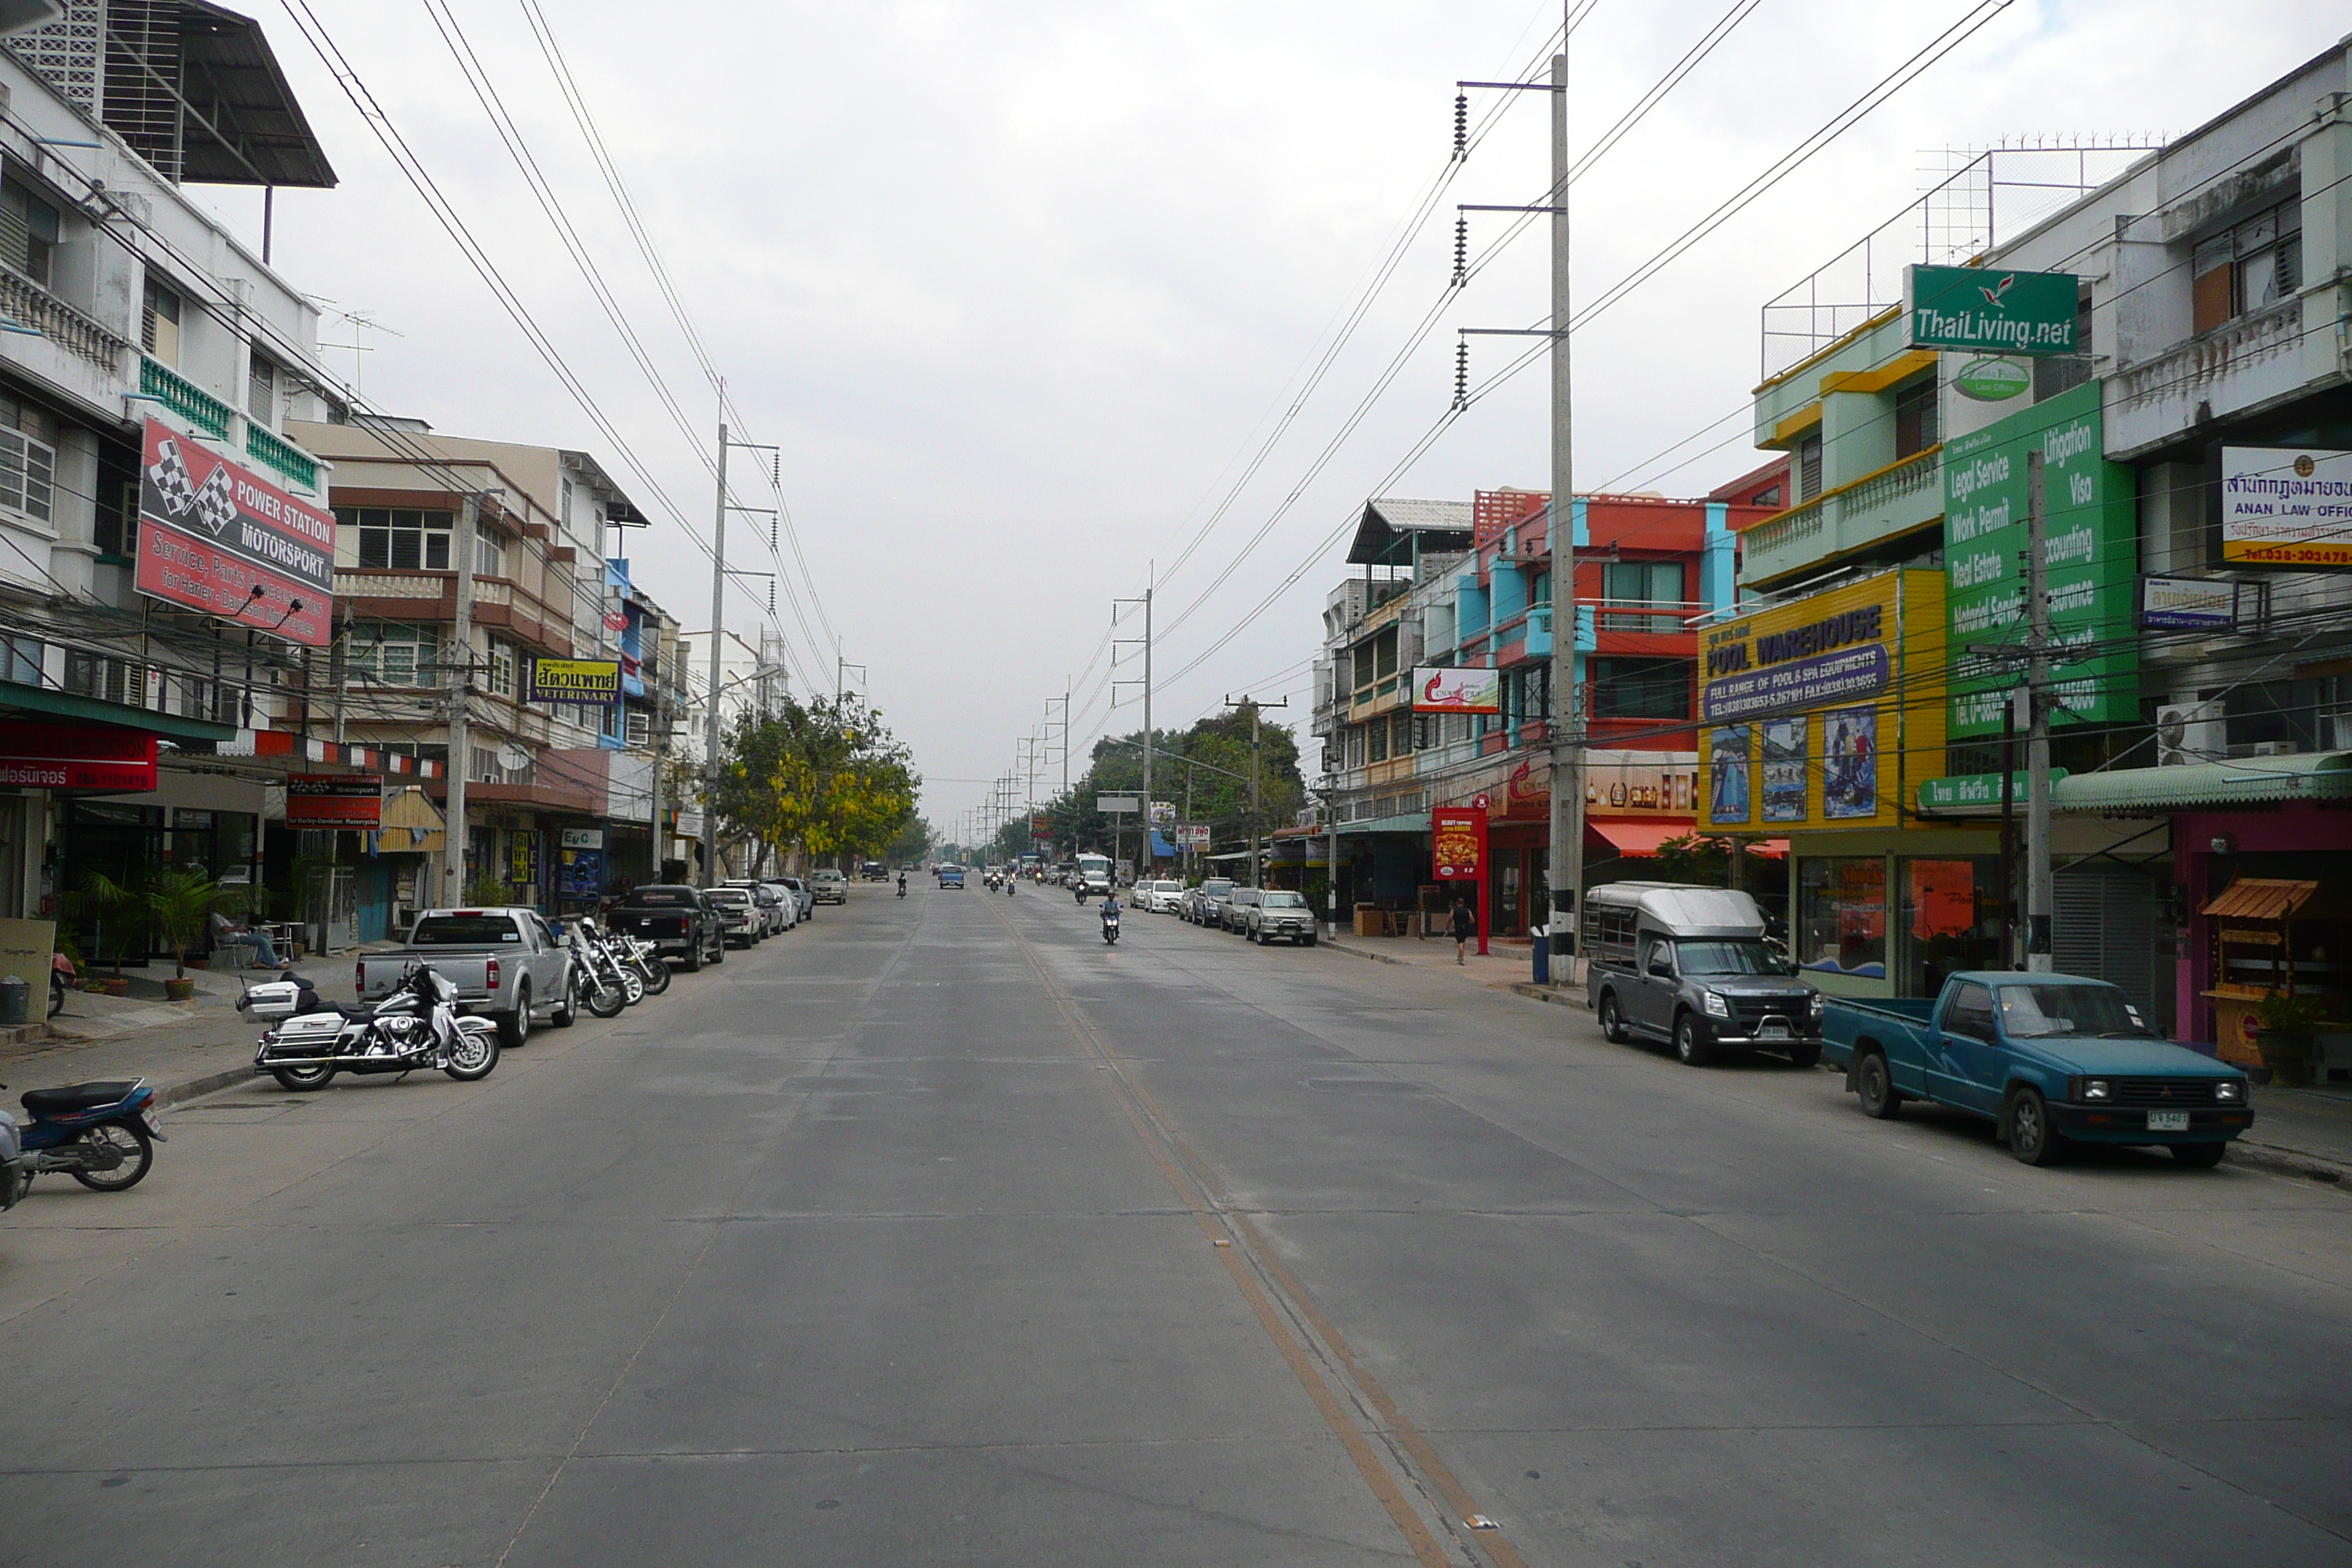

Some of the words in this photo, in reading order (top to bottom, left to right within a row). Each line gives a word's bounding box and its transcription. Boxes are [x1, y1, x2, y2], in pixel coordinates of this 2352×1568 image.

[1918, 309, 2071, 350] ThaiLiving.net
[1975, 382, 1991, 391] Law
[1993, 383, 2016, 392] Office
[2044, 420, 2091, 468] Litigation
[1952, 460, 1975, 503] Legal
[1976, 452, 2010, 489] Service
[2070, 472, 2092, 505] Visa
[237, 480, 282, 521] POWER
[283, 505, 331, 544] STATION
[1952, 508, 1975, 543] Work
[1979, 497, 2010, 535] Permit
[2235, 502, 2273, 515] ANAN
[2282, 504, 2311, 516] LAW
[153, 531, 209, 580] Service,
[212, 556, 245, 588] Parts
[241, 522, 325, 578] MOTORSPORT
[1953, 554, 1972, 589] Real
[1974, 549, 2002, 587] Estate
[162, 568, 178, 587] for
[182, 576, 214, 605] Harley
[1954, 596, 1989, 635] Notarial
[1707, 643, 1752, 676] POOL
[1757, 604, 1882, 665] WAREHOUSE
[536, 689, 617, 701] VETERINARY
[1710, 685, 1727, 701] FULL
[1728, 680, 1754, 697] RANGE
[1757, 676, 1769, 691] OF
[1772, 672, 1793, 687] POOL
[1795, 668, 1802, 683] &
[1803, 665, 1820, 682] SPA
[1820, 650, 1877, 678] EQUIPMENTS
[1955, 696, 1968, 725] Tel.
[336, 786, 375, 795] Motorsport
[1932, 781, 1953, 802] ไทย
[345, 818, 379, 826] Motorcycles
[529, 832, 538, 883] VET
